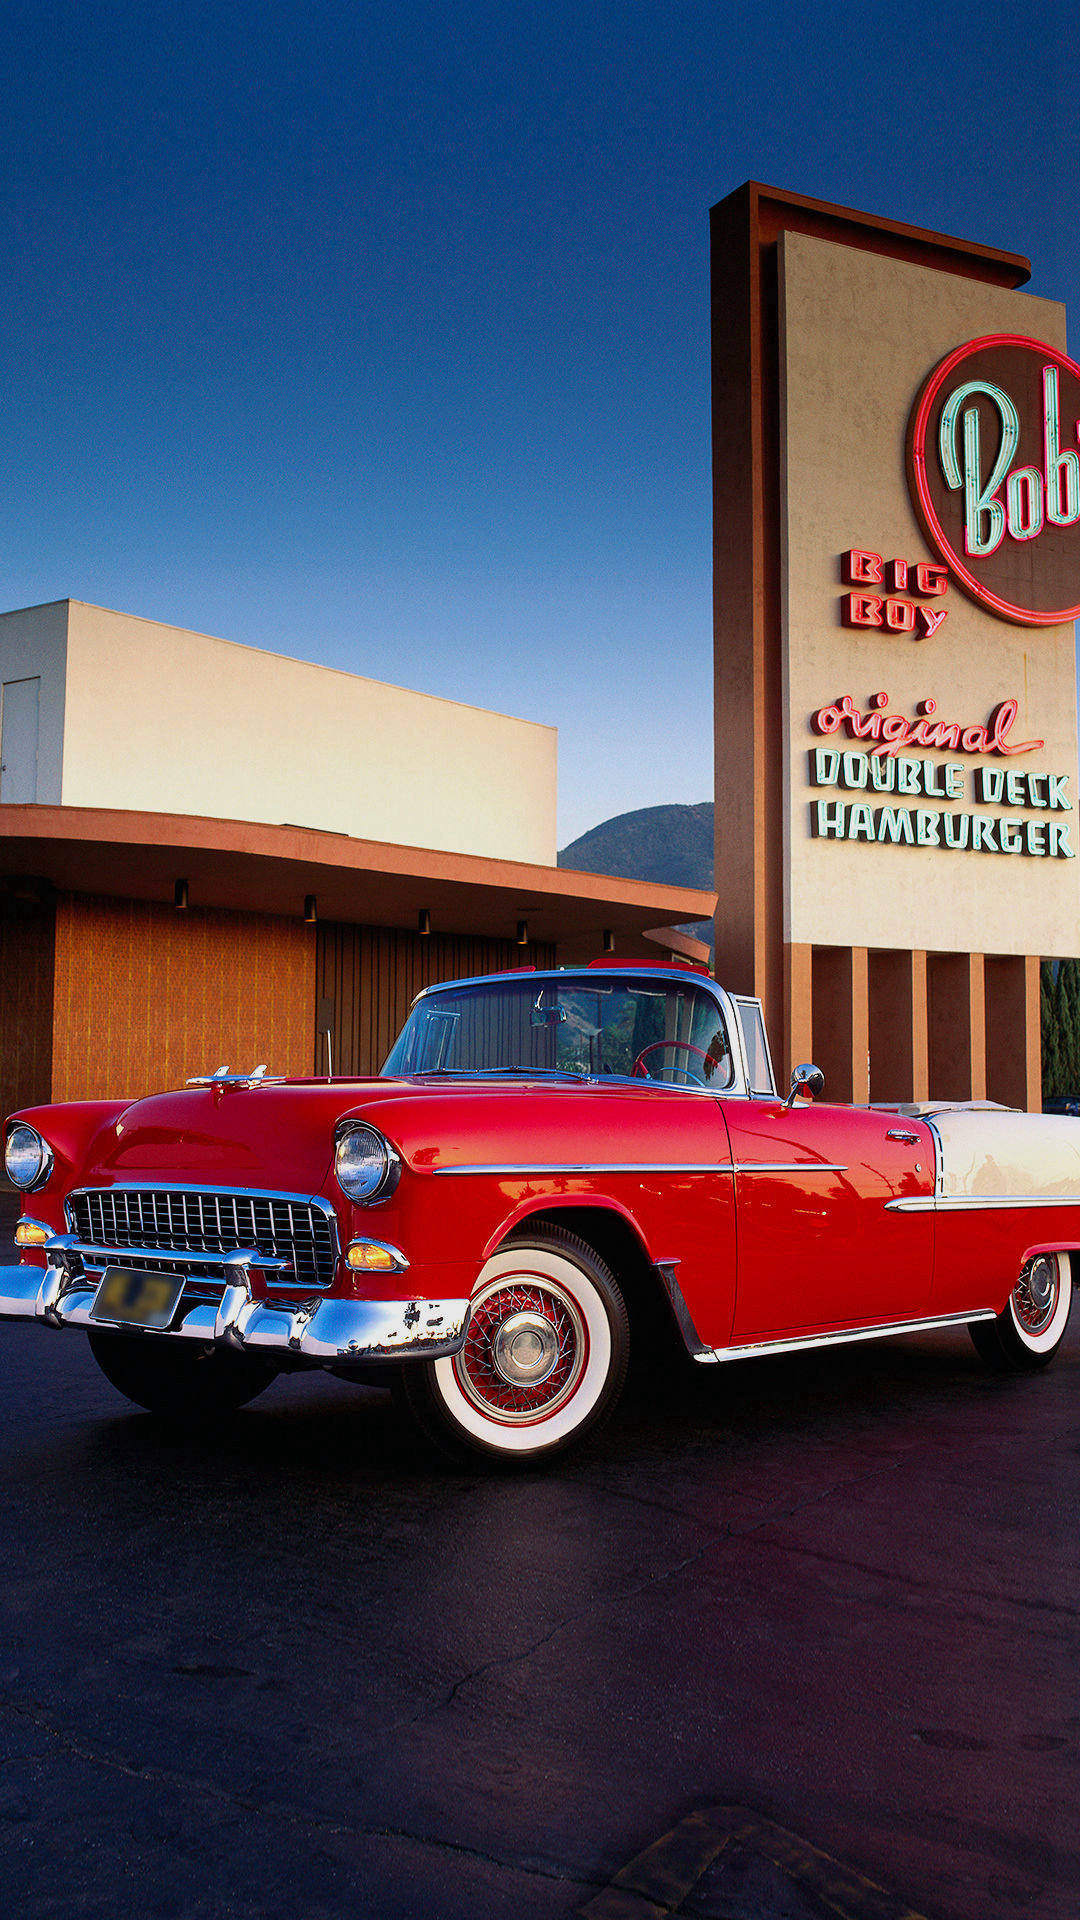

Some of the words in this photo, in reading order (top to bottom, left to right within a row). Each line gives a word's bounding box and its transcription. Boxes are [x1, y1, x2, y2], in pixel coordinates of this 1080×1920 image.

[940, 365, 1080, 557] Bob
[847, 549, 949, 596] BIG
[847, 592, 948, 638] BOY
[815, 692, 1045, 757] original
[813, 747, 965, 800] DOUBLE
[979, 766, 1073, 810] DECK
[814, 799, 1076, 858] HAMBURGER
